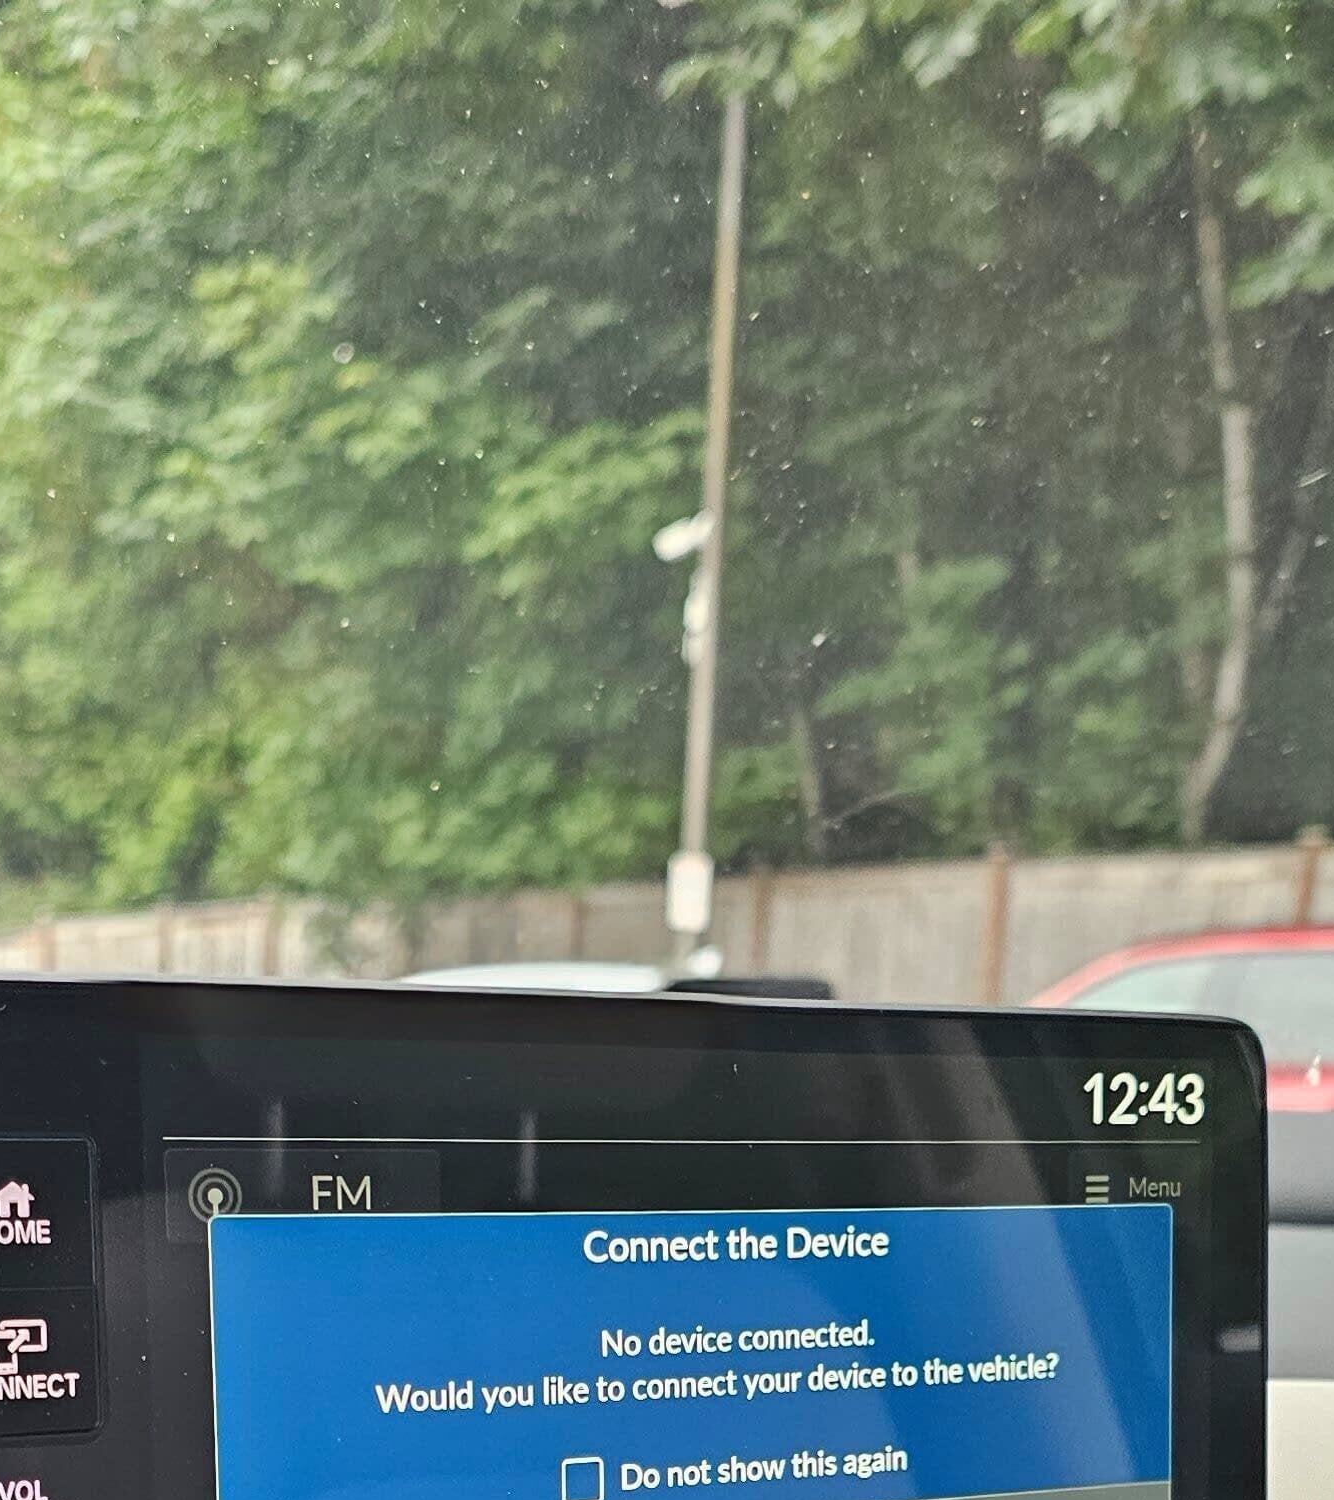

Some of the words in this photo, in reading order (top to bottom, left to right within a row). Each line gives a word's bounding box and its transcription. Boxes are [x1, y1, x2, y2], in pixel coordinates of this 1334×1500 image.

[1082, 1071, 1206, 1126] 12:43
[311, 1175, 372, 1211] FM
[1128, 1176, 1182, 1199] Menu
[583, 1229, 719, 1265] Connect
[726, 1227, 778, 1261] the
[786, 1225, 890, 1259] Device
[600, 1330, 642, 1358] No
[648, 1325, 732, 1356] device
[738, 1318, 875, 1352] connected.
[375, 1380, 474, 1414] Would
[481, 1384, 534, 1415] you
[542, 1375, 590, 1405] like
[597, 1378, 625, 1402] to
[632, 1374, 738, 1401] connect
[746, 1370, 802, 1401] your
[808, 1362, 886, 1393] device
[891, 1362, 919, 1388] to
[923, 1357, 964, 1385] the
[967, 1352, 1060, 1382] vehicle?
[621, 1463, 661, 1492] Do
[667, 1459, 712, 1488] not
[717, 1455, 786, 1485] show
[791, 1449, 838, 1478] this
[843, 1445, 909, 1478] again
